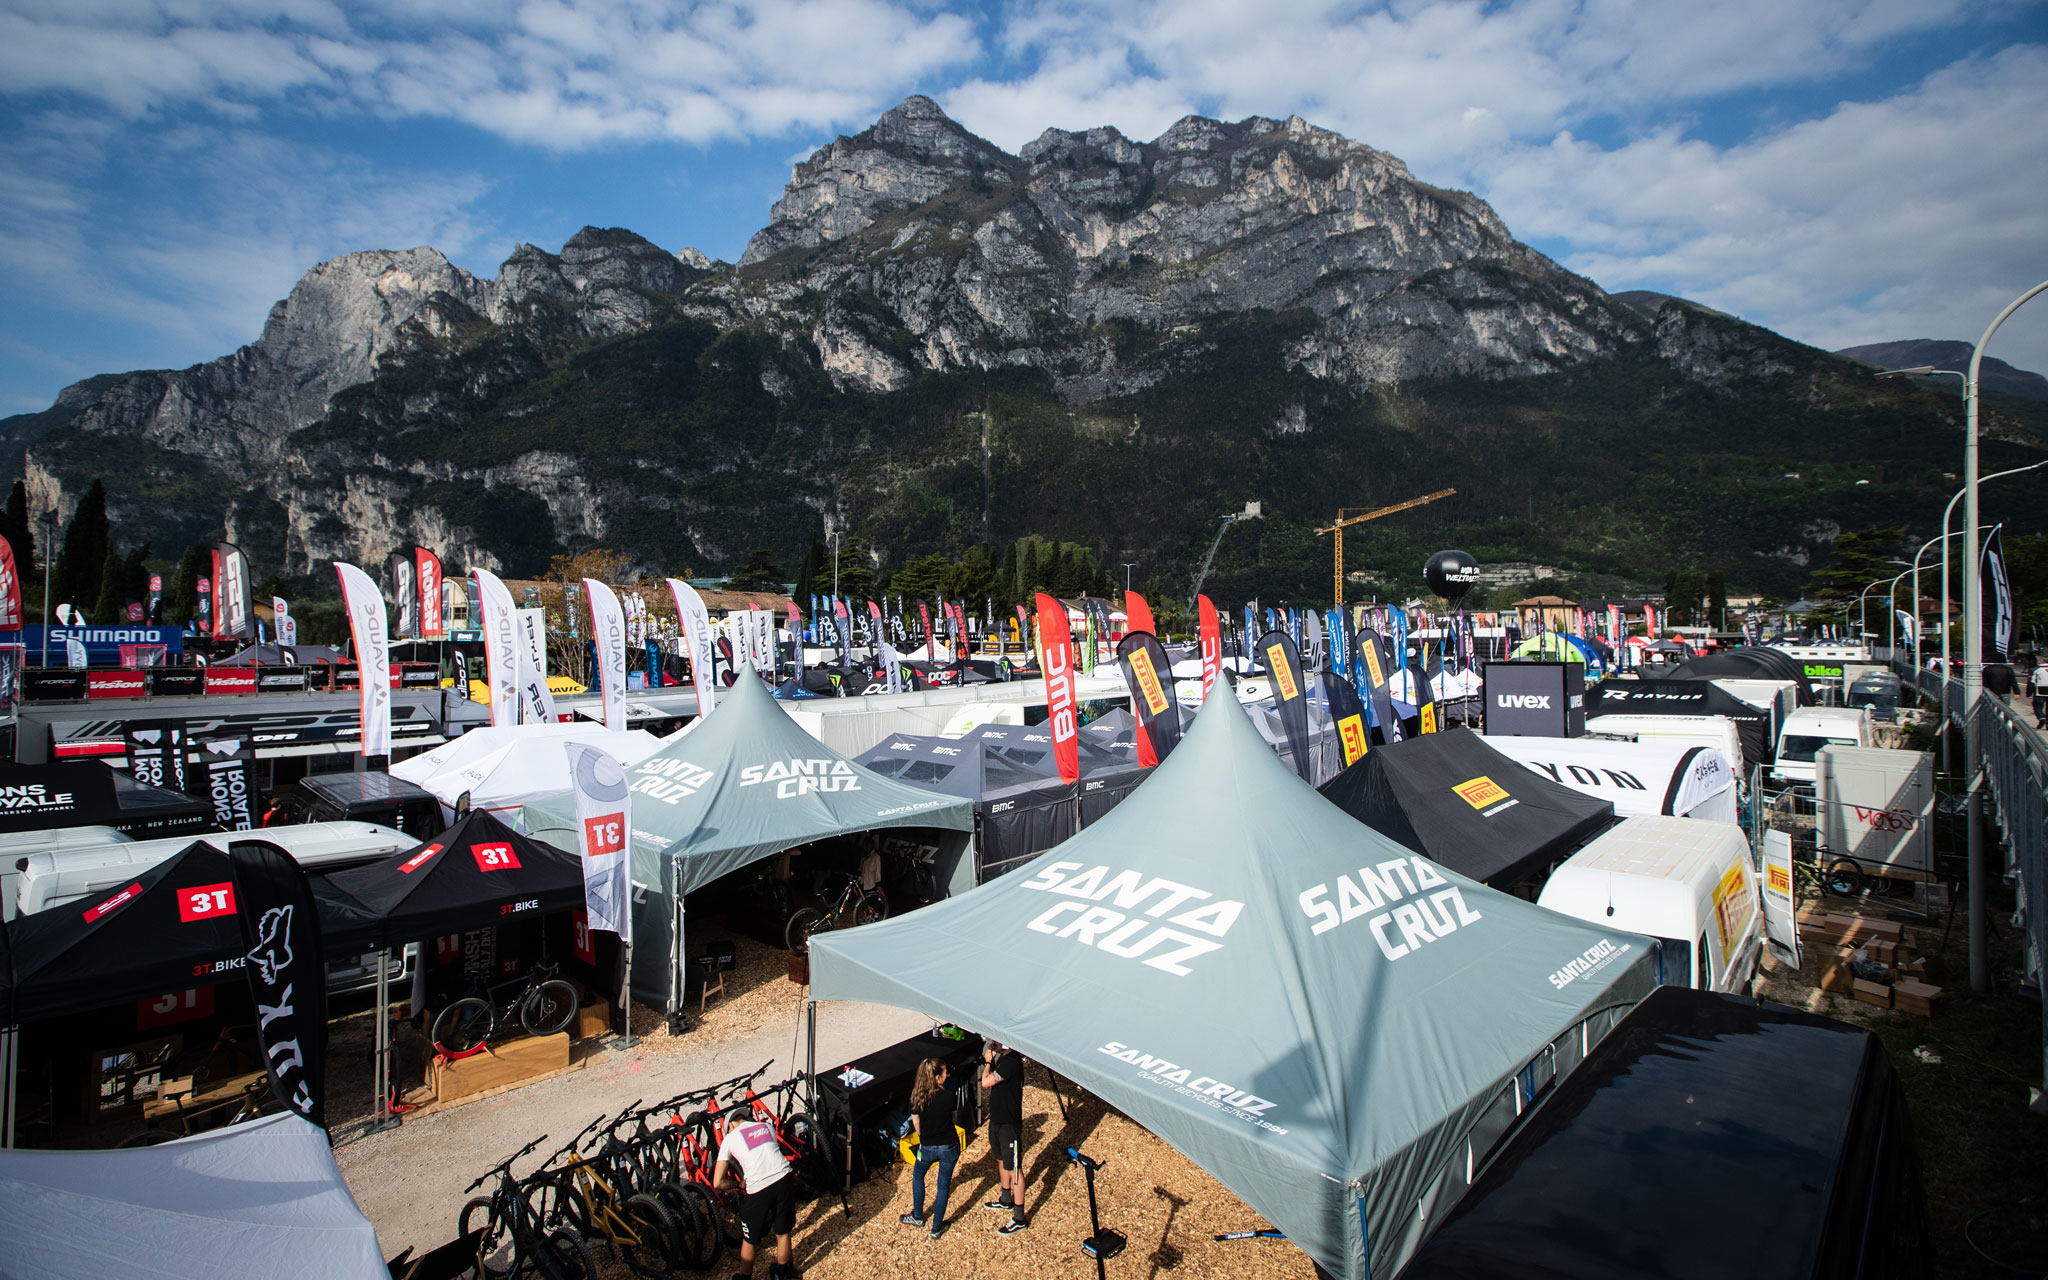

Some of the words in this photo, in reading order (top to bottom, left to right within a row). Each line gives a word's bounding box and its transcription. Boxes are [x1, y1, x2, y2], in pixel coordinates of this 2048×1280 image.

[50, 629, 161, 643] SHIMANO
[1803, 665, 1843, 677] bike
[89, 679, 145, 690] Vision
[208, 677, 255, 687] Vision
[1498, 694, 1551, 709] uvex
[1570, 694, 1583, 709] uvex
[982, 731, 1007, 739] BMC
[1023, 734, 1052, 743] BMC
[891, 742, 917, 751] BMC
[932, 746, 961, 756] BMC
[636, 758, 714, 788] SANTA
[740, 759, 854, 787] SANTA
[1530, 762, 1647, 791] YON
[630, 777, 697, 805] CRUZ
[777, 774, 862, 799] CRUZ
[1086, 780, 1104, 791] BMC
[1460, 781, 1501, 805] PIRELLI
[0, 793, 74, 808] YALE
[37, 805, 76, 813] APPAREL
[877, 805, 912, 817] SANTA
[911, 800, 938, 810] CRUZ
[992, 801, 1015, 813] BMC
[115, 824, 132, 832] AKA
[168, 817, 203, 826] ZEALAND
[482, 846, 509, 865] 3T
[190, 889, 228, 913] 3T
[1019, 861, 1245, 938] SANTA
[1298, 855, 1448, 936] SANTA
[500, 899, 539, 915] 3T.BIKE
[1368, 886, 1483, 960] CRUZ
[576, 921, 590, 953] 3T
[1026, 900, 1225, 977] CRUZ
[193, 957, 247, 976] 3T.BIKE
[504, 960, 517, 972] 3T
[1548, 957, 1593, 990] SANTA
[1583, 938, 1617, 965] CRUZ
[153, 989, 197, 1014] 3T
[1097, 1041, 1192, 1085] SANTA
[1187, 1077, 1278, 1117] CRUZ
[1137, 1070, 1178, 1090] QUALITY
[1174, 1086, 1224, 1109] BICYCLES
[1221, 1105, 1256, 1123] SINCE
[1254, 1118, 1289, 1136] 1994
[741, 1221, 751, 1240] FOX
